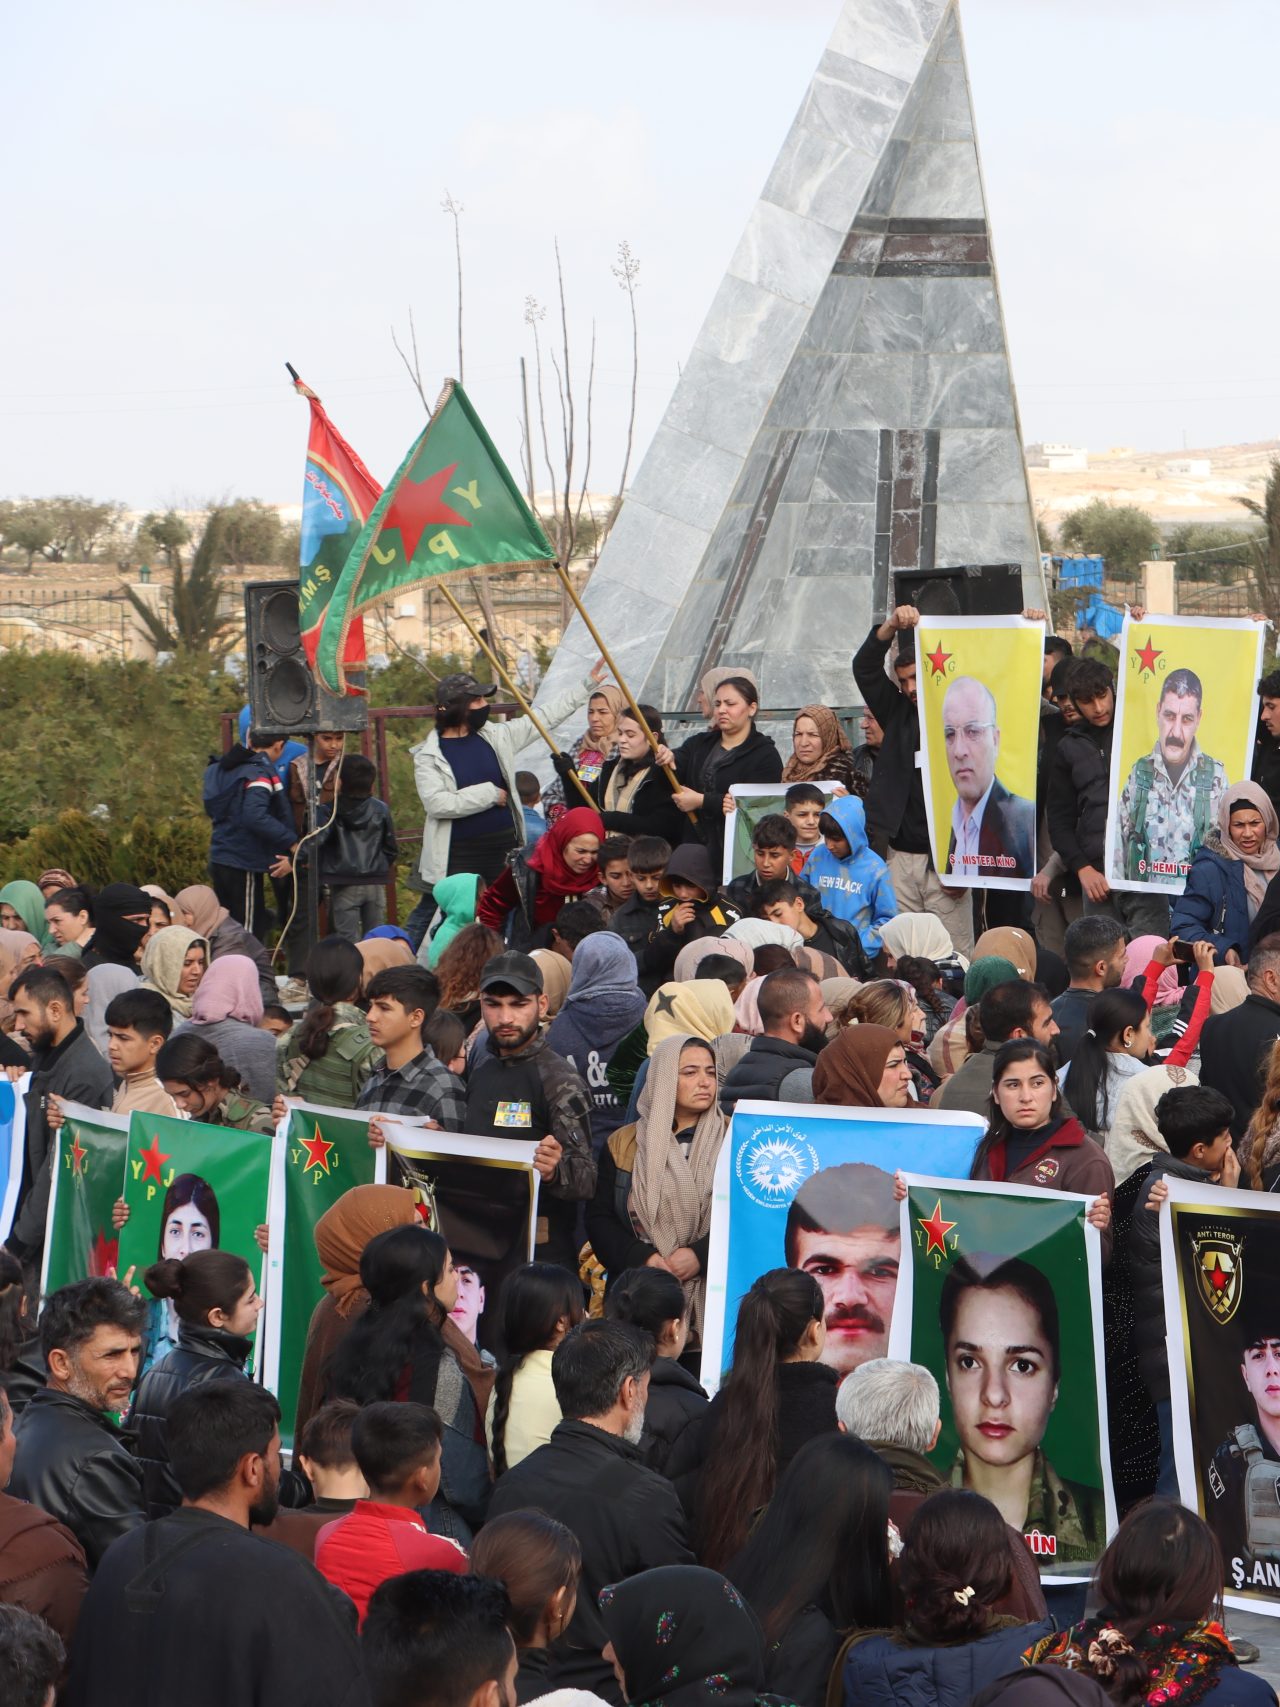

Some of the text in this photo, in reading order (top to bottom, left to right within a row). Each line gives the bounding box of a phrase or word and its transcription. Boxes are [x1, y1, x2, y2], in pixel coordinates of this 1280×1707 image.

[819, 875, 863, 894] NEW BLACK
[1213, 1231, 1235, 1241] TEROR
